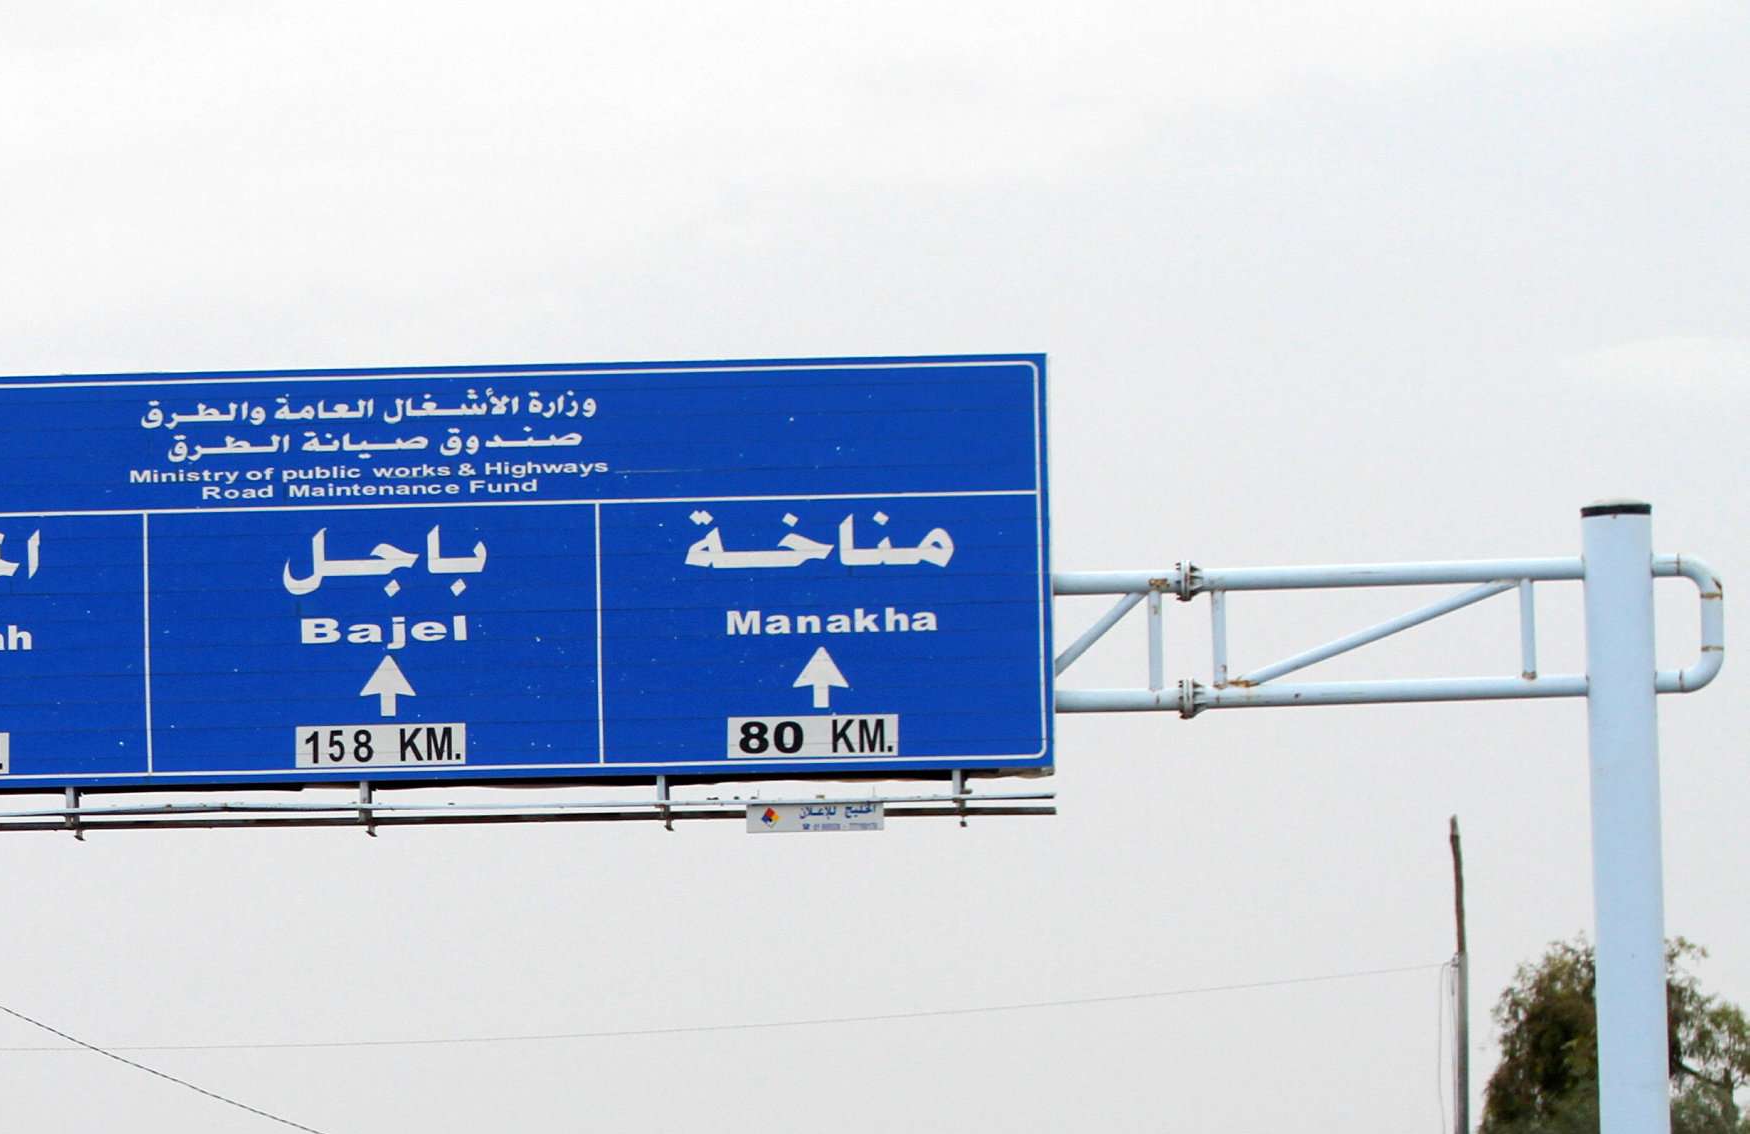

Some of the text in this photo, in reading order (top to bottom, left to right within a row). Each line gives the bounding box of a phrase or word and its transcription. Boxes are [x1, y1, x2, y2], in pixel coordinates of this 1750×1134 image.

[140, 387, 597, 429] وزارة الأشغال العامة والطرق
[167, 426, 584, 463] صندوق صيانة الطرق
[129, 461, 610, 485] Ministry of public works & Highways
[202, 479, 539, 500] Road Maintenance Fund
[684, 509, 956, 570] مناخة
[281, 525, 488, 598] باجل
[299, 613, 469, 650] Bajel
[725, 606, 939, 637] Manakha
[303, 724, 463, 765] 158 KM.
[737, 718, 895, 756] 80 KM.
